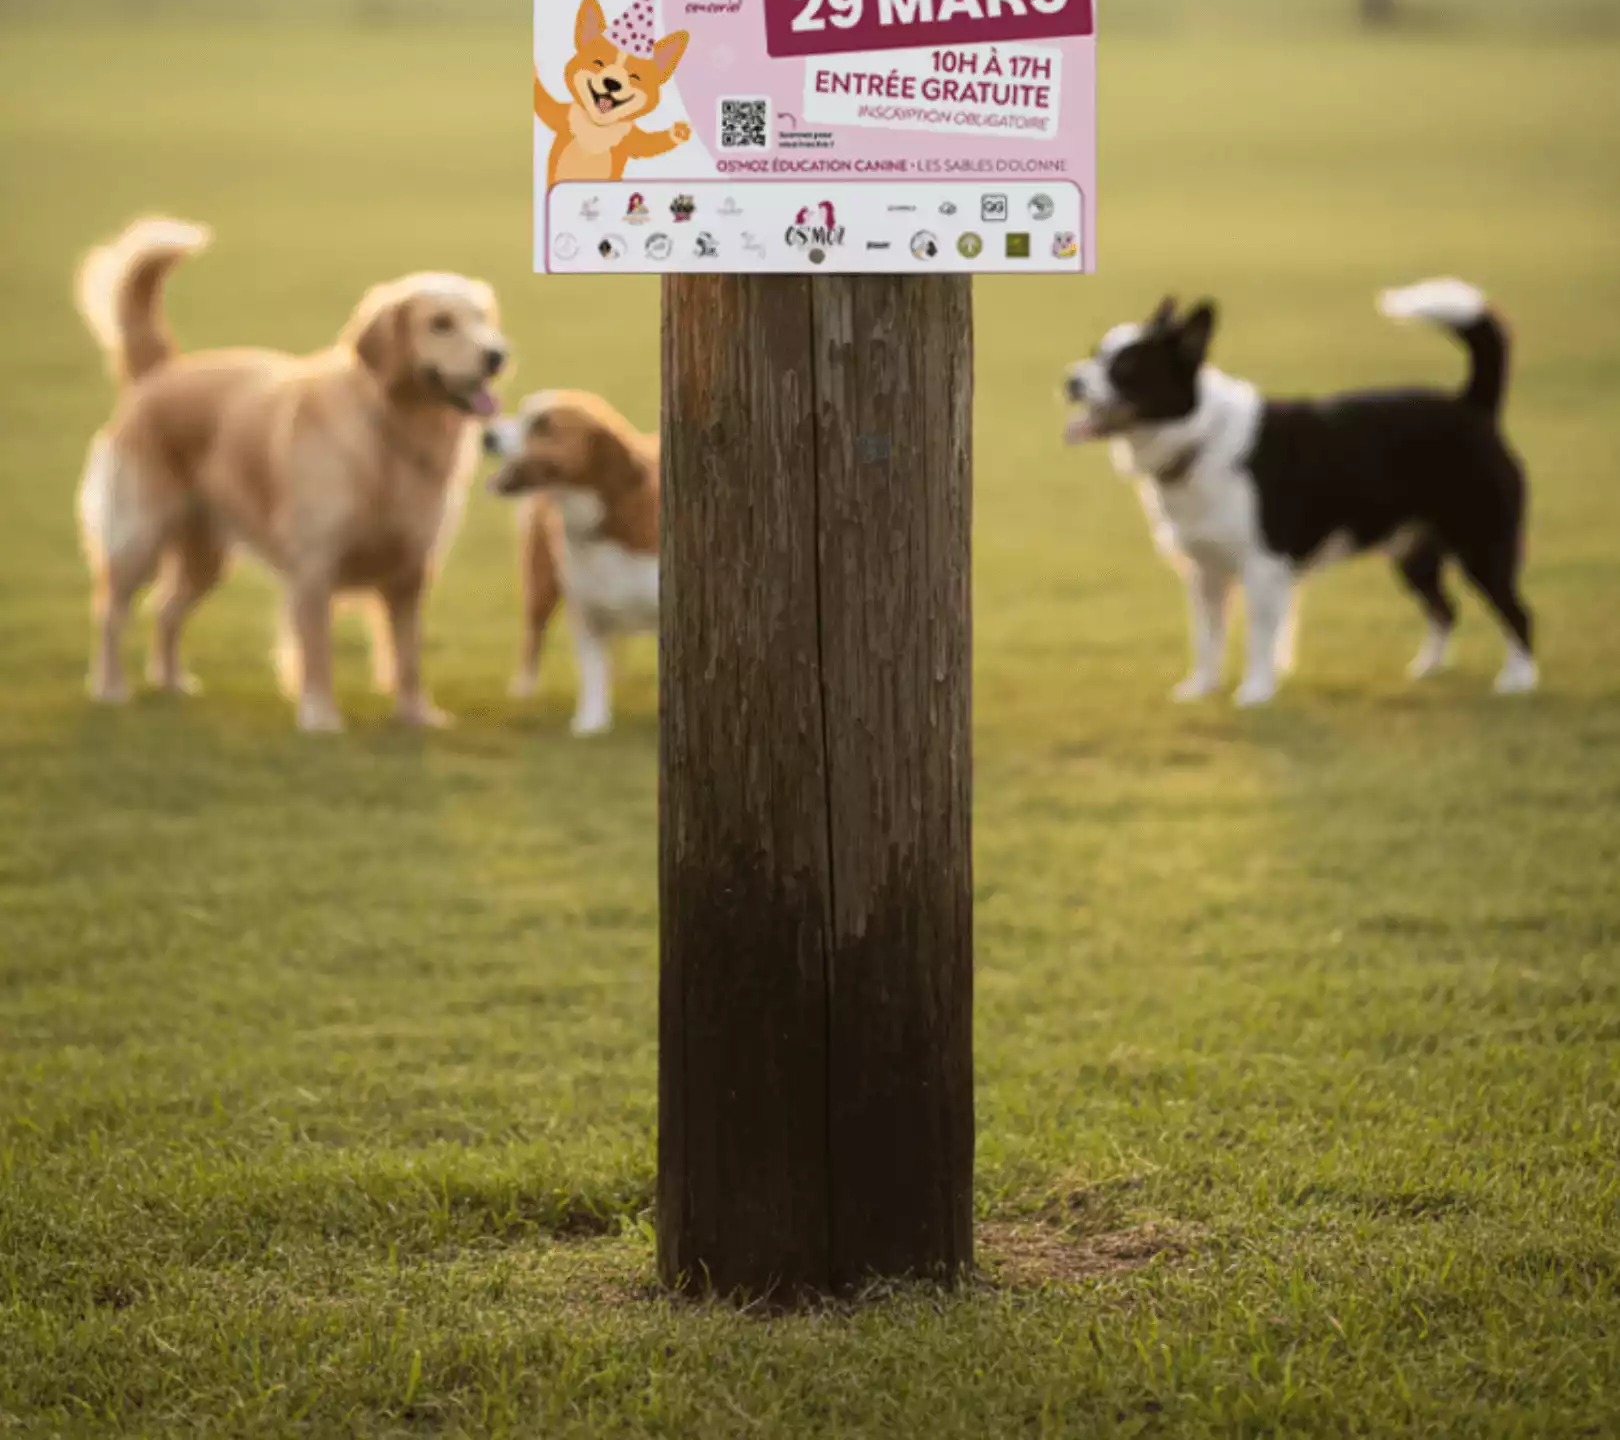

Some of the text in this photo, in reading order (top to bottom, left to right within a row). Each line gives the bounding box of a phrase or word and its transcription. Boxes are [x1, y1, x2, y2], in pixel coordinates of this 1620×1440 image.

[932, 47, 1051, 79] 10H À 17H
[816, 69, 1050, 108] ENTRÉE GRATUITE
[772, 158, 851, 172] ÉDUCATION
[854, 159, 907, 172] CANINE
